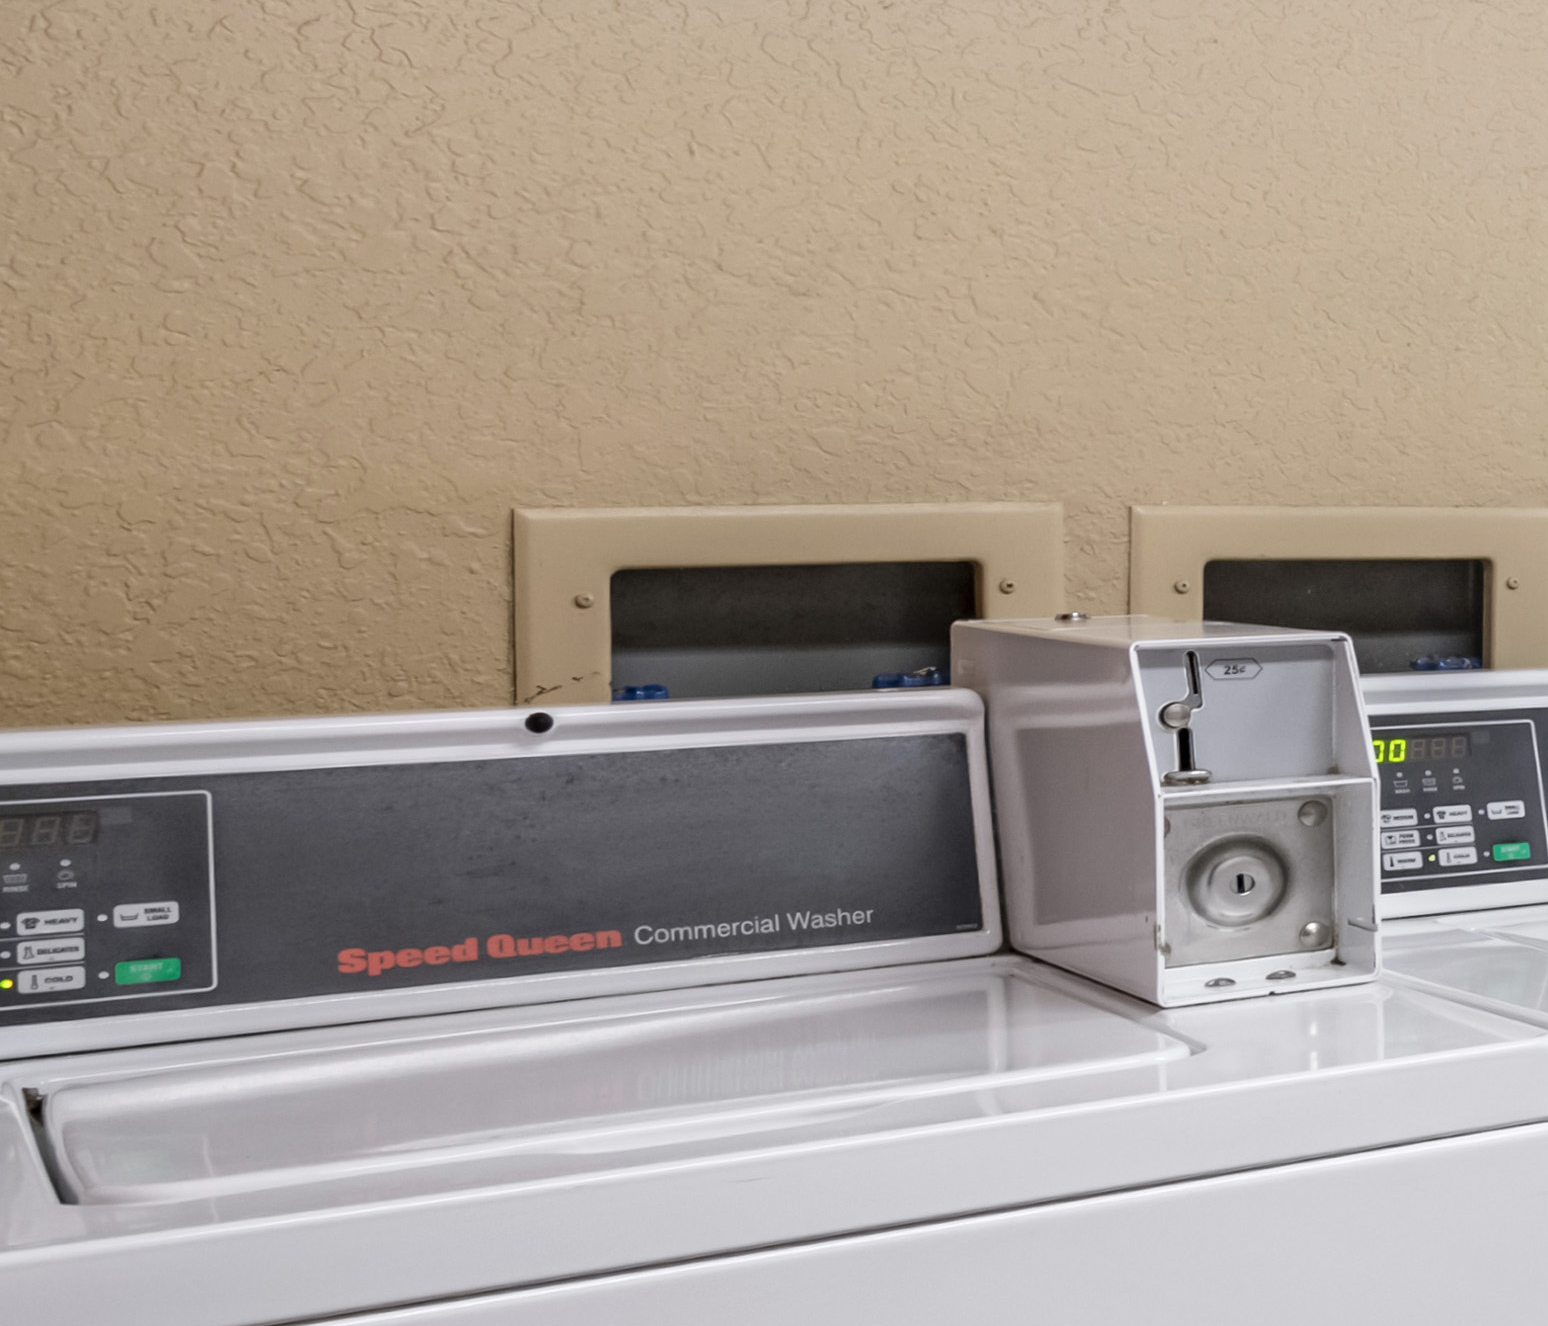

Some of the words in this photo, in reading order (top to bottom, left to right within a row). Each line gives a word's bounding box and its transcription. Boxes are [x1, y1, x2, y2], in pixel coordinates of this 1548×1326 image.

[43, 916, 79, 926] HEAVY
[337, 937, 479, 976] Speed
[485, 929, 623, 960] Queen
[634, 914, 781, 946] Commercial
[786, 906, 875, 932] Washer
